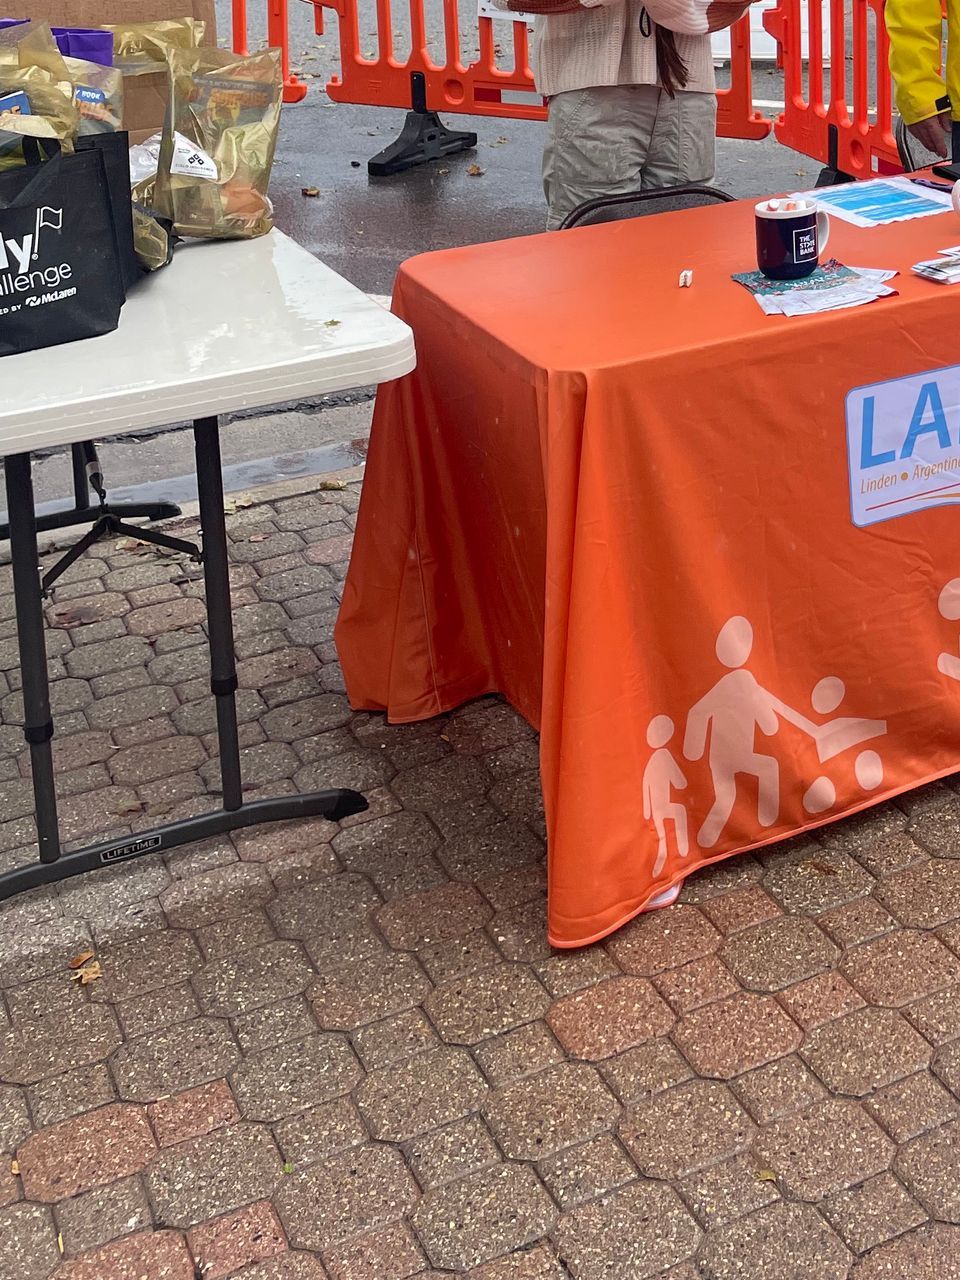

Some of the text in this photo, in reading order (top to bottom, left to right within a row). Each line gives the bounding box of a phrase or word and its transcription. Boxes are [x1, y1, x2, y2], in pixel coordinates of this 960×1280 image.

[799, 234, 811, 242] THE
[799, 247, 815, 255] BANK
[0, 263, 72, 297] llenge
[11, 304, 22, 313] BY
[41, 286, 77, 304] McLaren
[860, 472, 897, 494] Linden
[106, 839, 156, 859] LIFETIME
